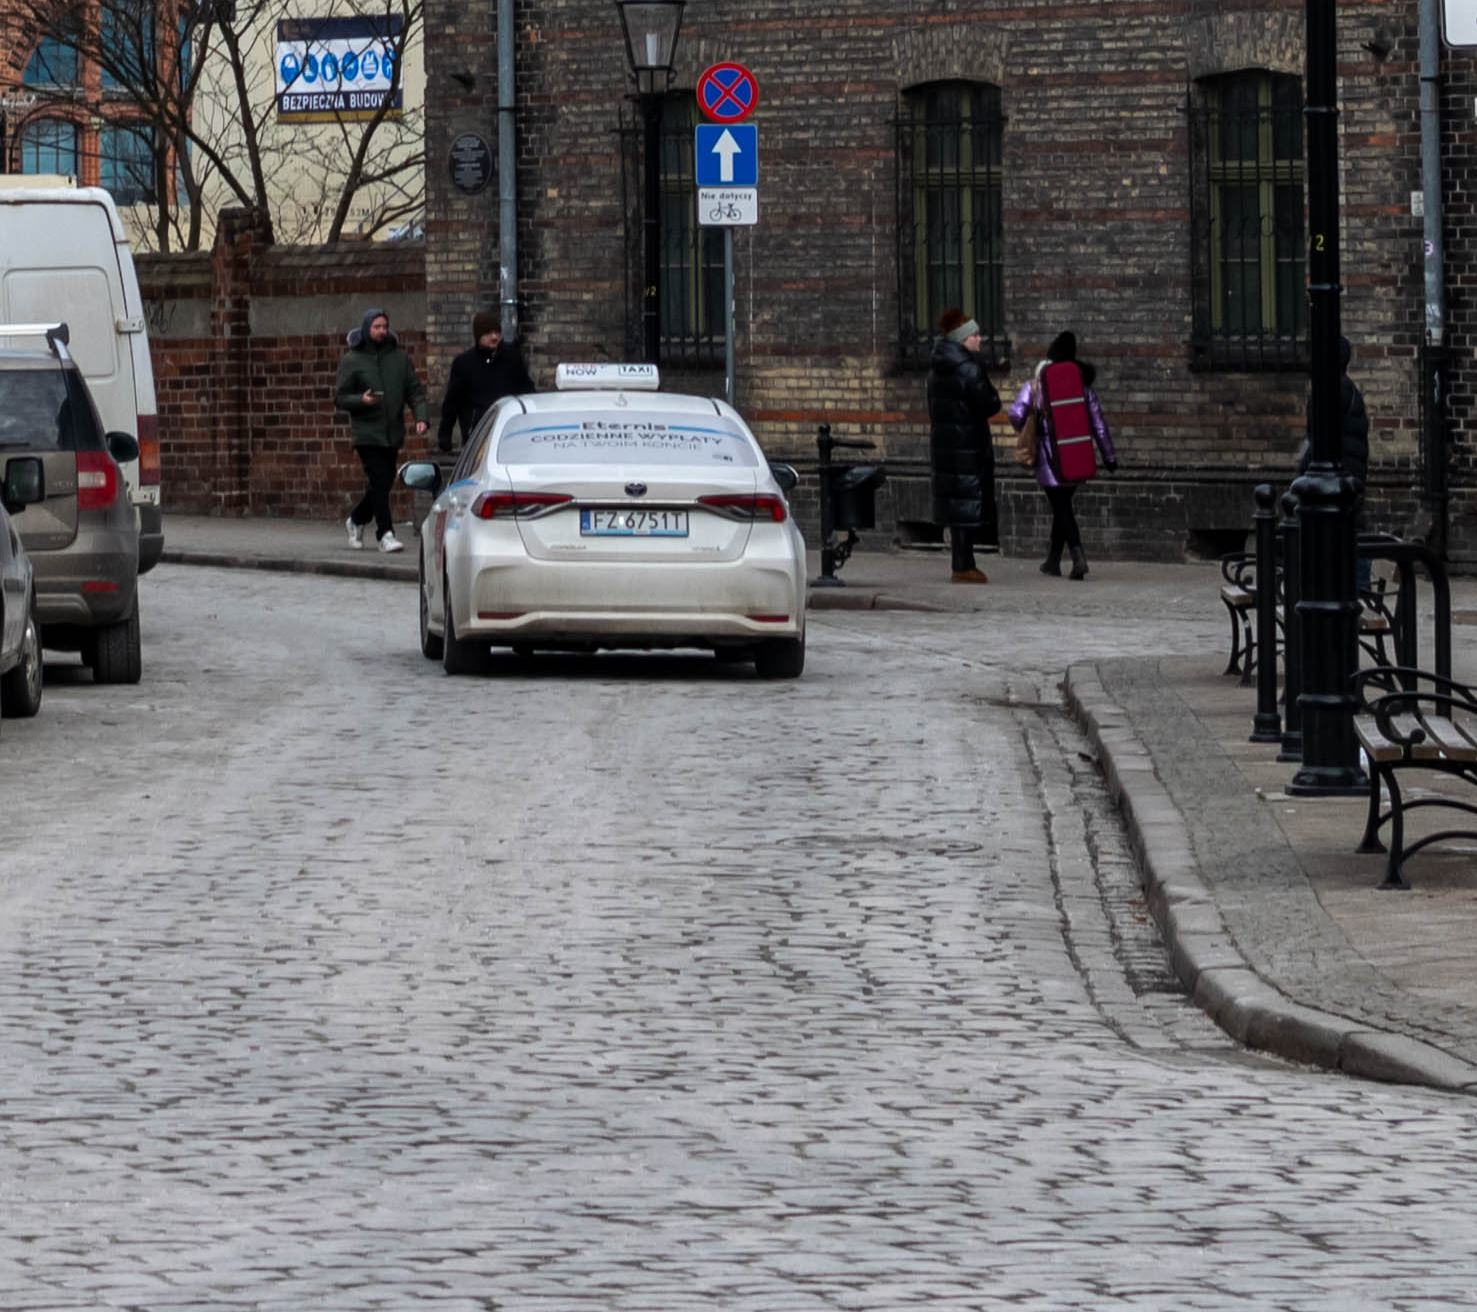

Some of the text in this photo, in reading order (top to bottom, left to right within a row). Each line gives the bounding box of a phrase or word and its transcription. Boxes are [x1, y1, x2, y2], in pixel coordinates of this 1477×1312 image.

[282, 91, 396, 111] BEZPIECZNA BUDOW
[621, 366, 651, 374] TAXI
[582, 421, 667, 431] Eternis
[531, 432, 634, 444] CODZIENNE
[594, 512, 682, 530] FZ 6751T
